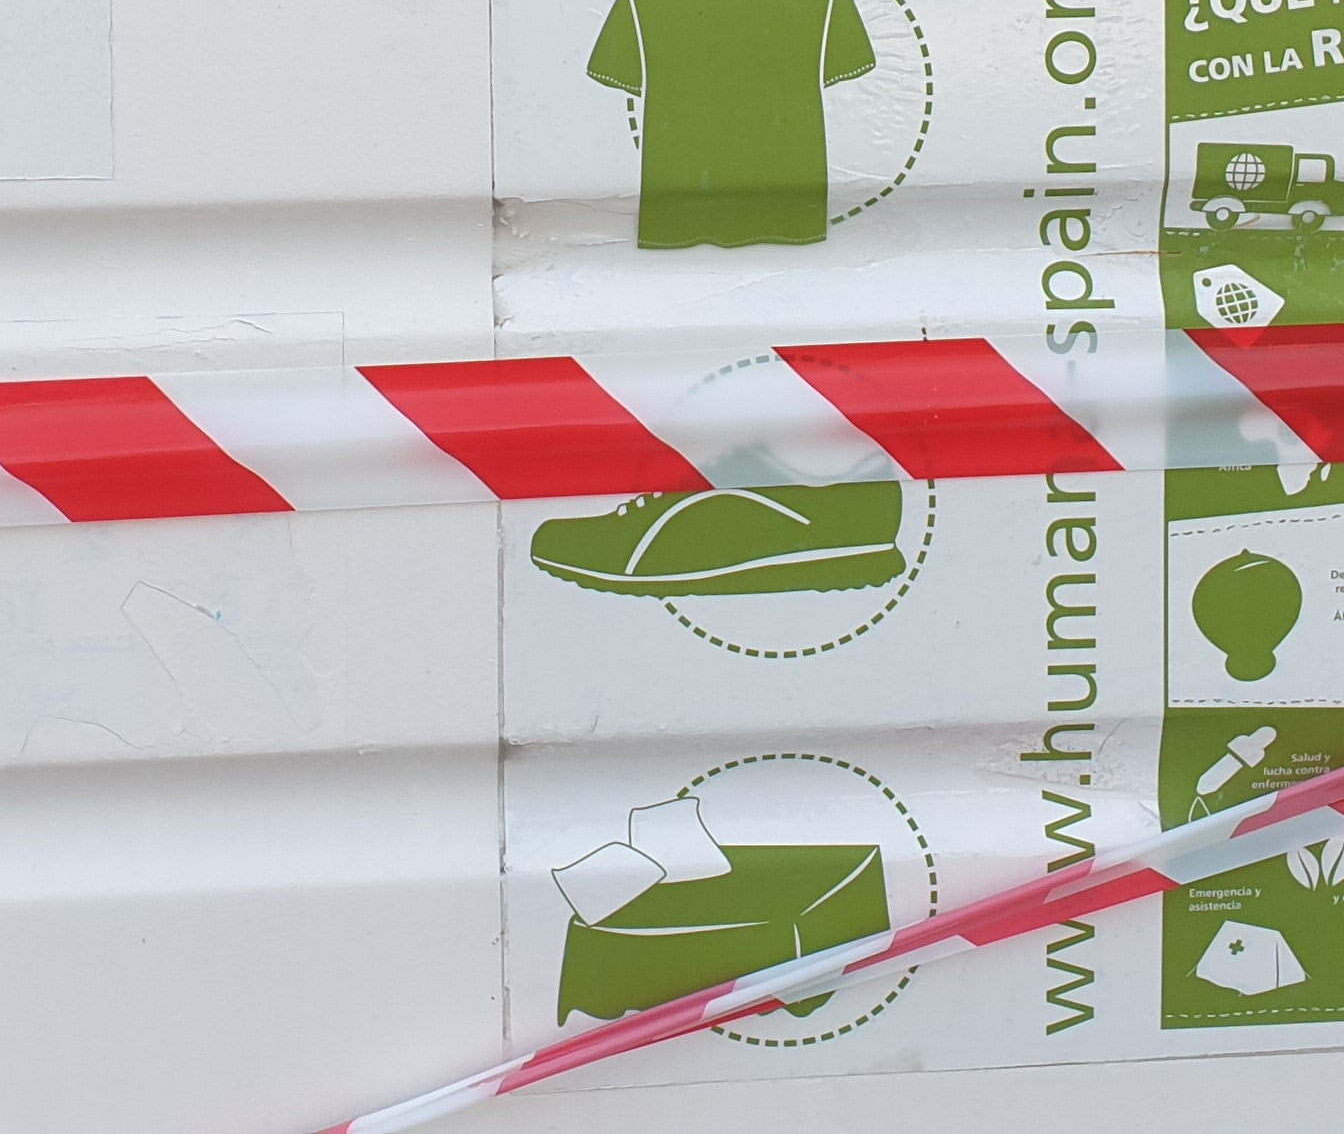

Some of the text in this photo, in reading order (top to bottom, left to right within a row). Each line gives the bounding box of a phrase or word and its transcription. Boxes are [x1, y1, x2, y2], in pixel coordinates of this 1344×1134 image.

[1188, 52, 1255, 83] CON
[1263, 45, 1304, 74] LA
[1291, 753, 1331, 763] Salud y
[1263, 766, 1330, 776] lucha contra
[1189, 886, 1262, 900] Emergencia y
[1332, 894, 1340, 905] y
[1188, 900, 1242, 912] asistencia
